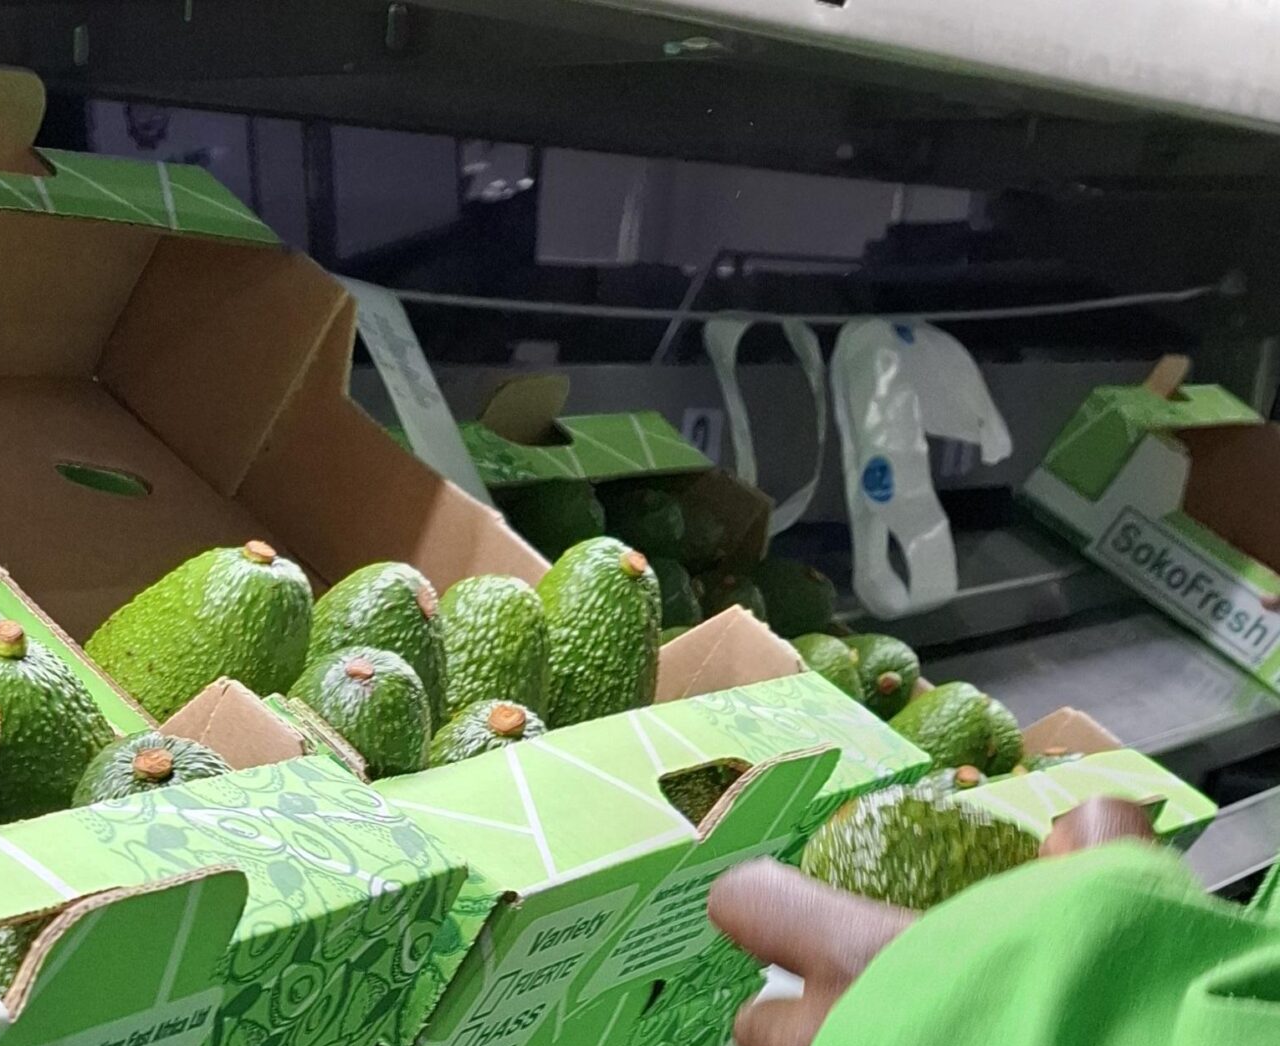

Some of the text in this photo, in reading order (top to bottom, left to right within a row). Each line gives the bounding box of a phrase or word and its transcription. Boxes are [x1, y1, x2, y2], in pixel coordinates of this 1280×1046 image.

[1111, 521, 1269, 648] SokoFresh
[527, 910, 615, 957] Variety
[506, 952, 585, 1000] FUERTE
